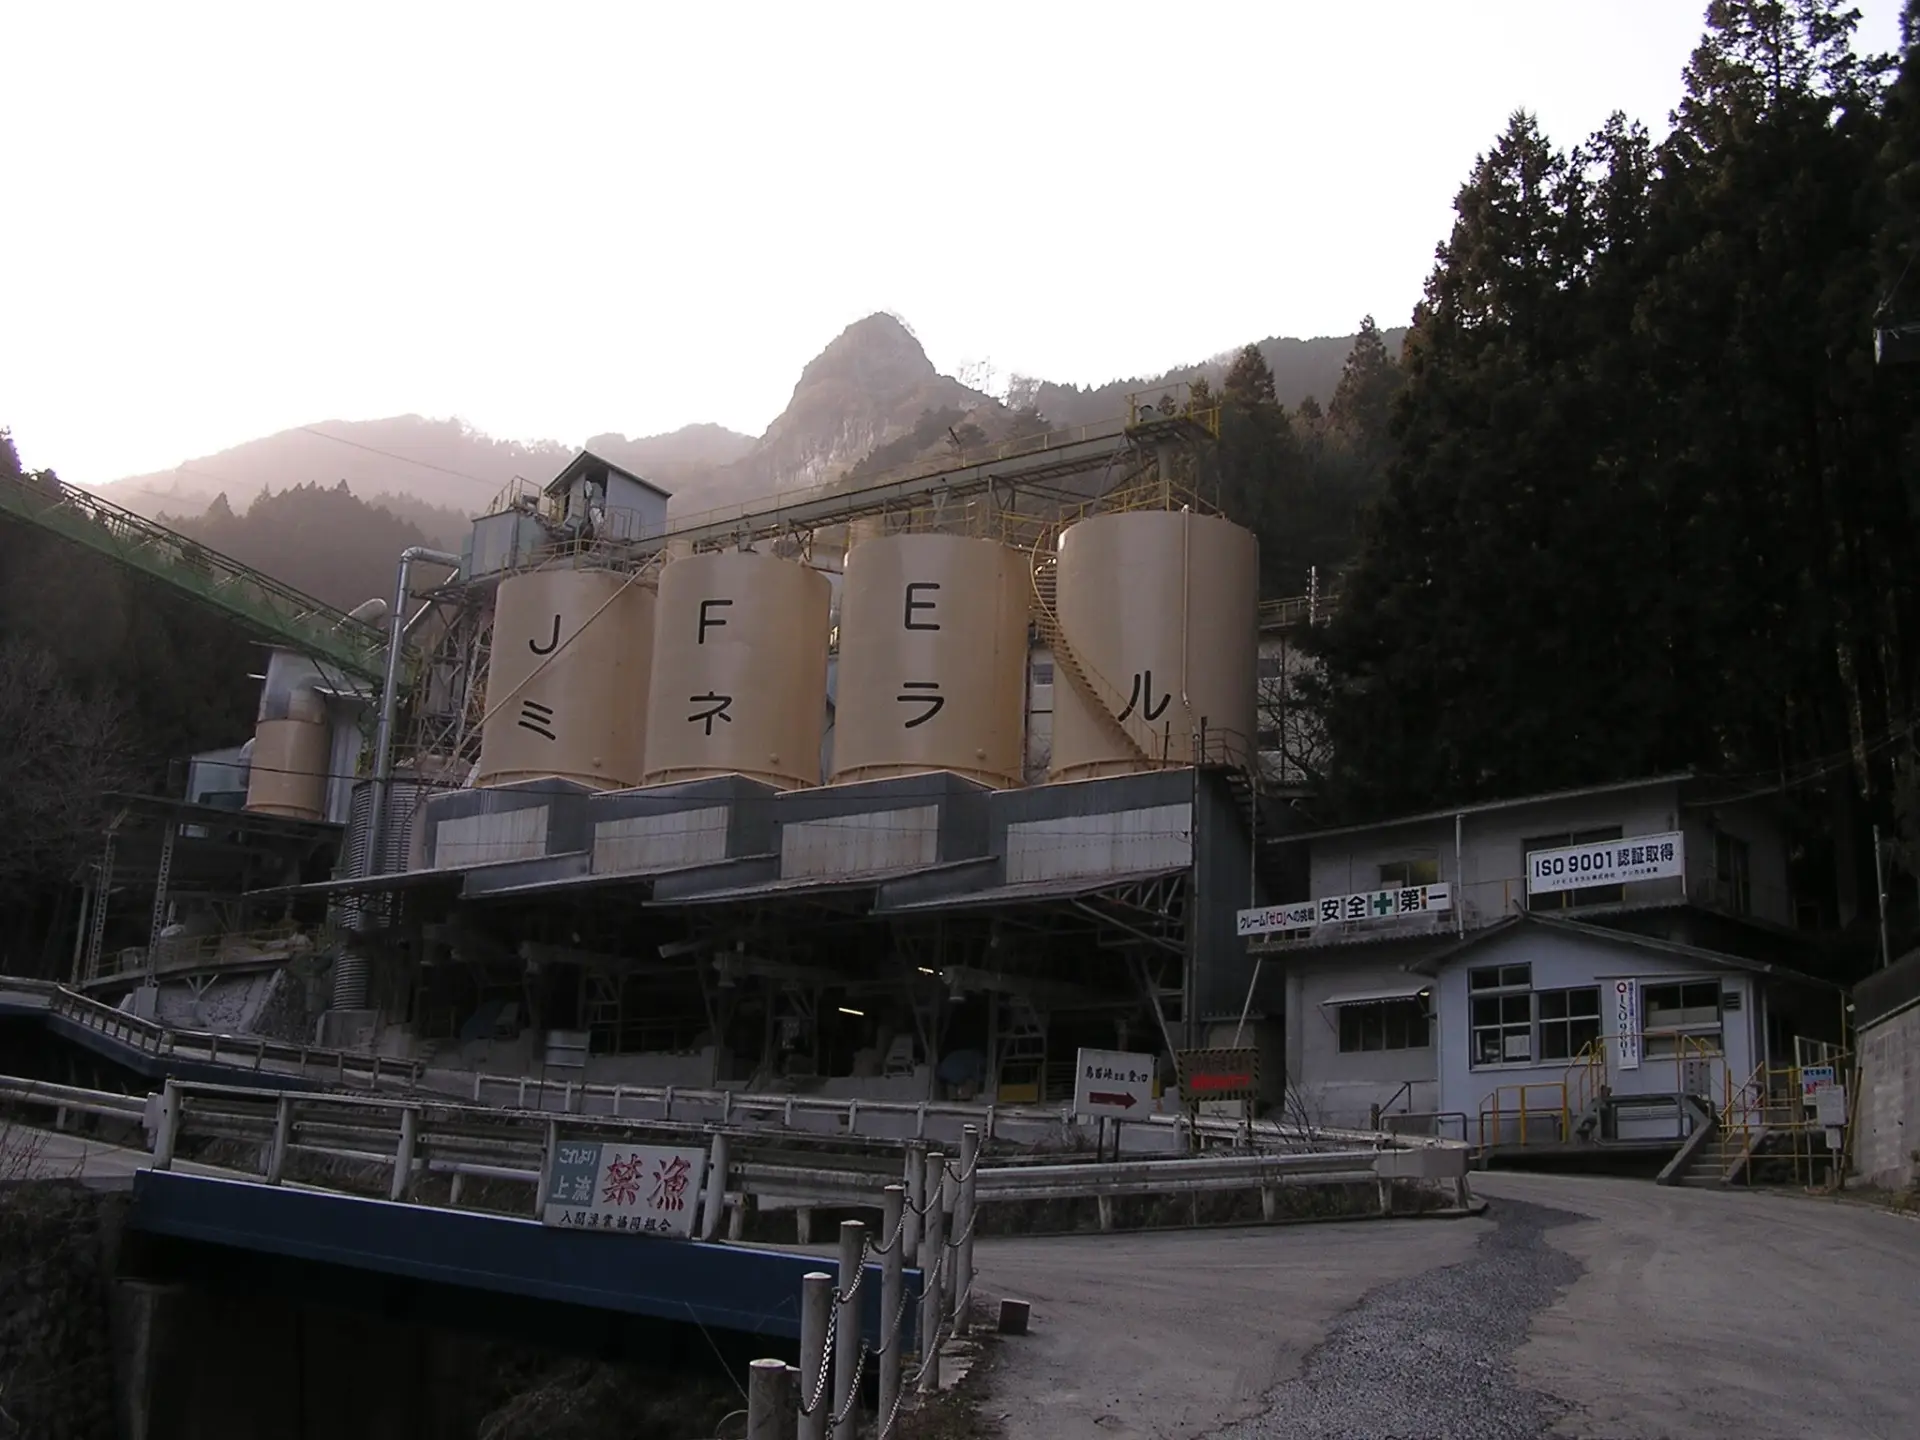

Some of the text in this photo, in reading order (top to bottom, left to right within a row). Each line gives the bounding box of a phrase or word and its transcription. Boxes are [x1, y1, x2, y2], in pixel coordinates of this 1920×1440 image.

[1535, 842, 1674, 878] ISO 9001 認証取得
[559, 1147, 598, 1167] これより
[551, 1174, 593, 1201] 上流
[601, 1152, 692, 1212] 禁漁
